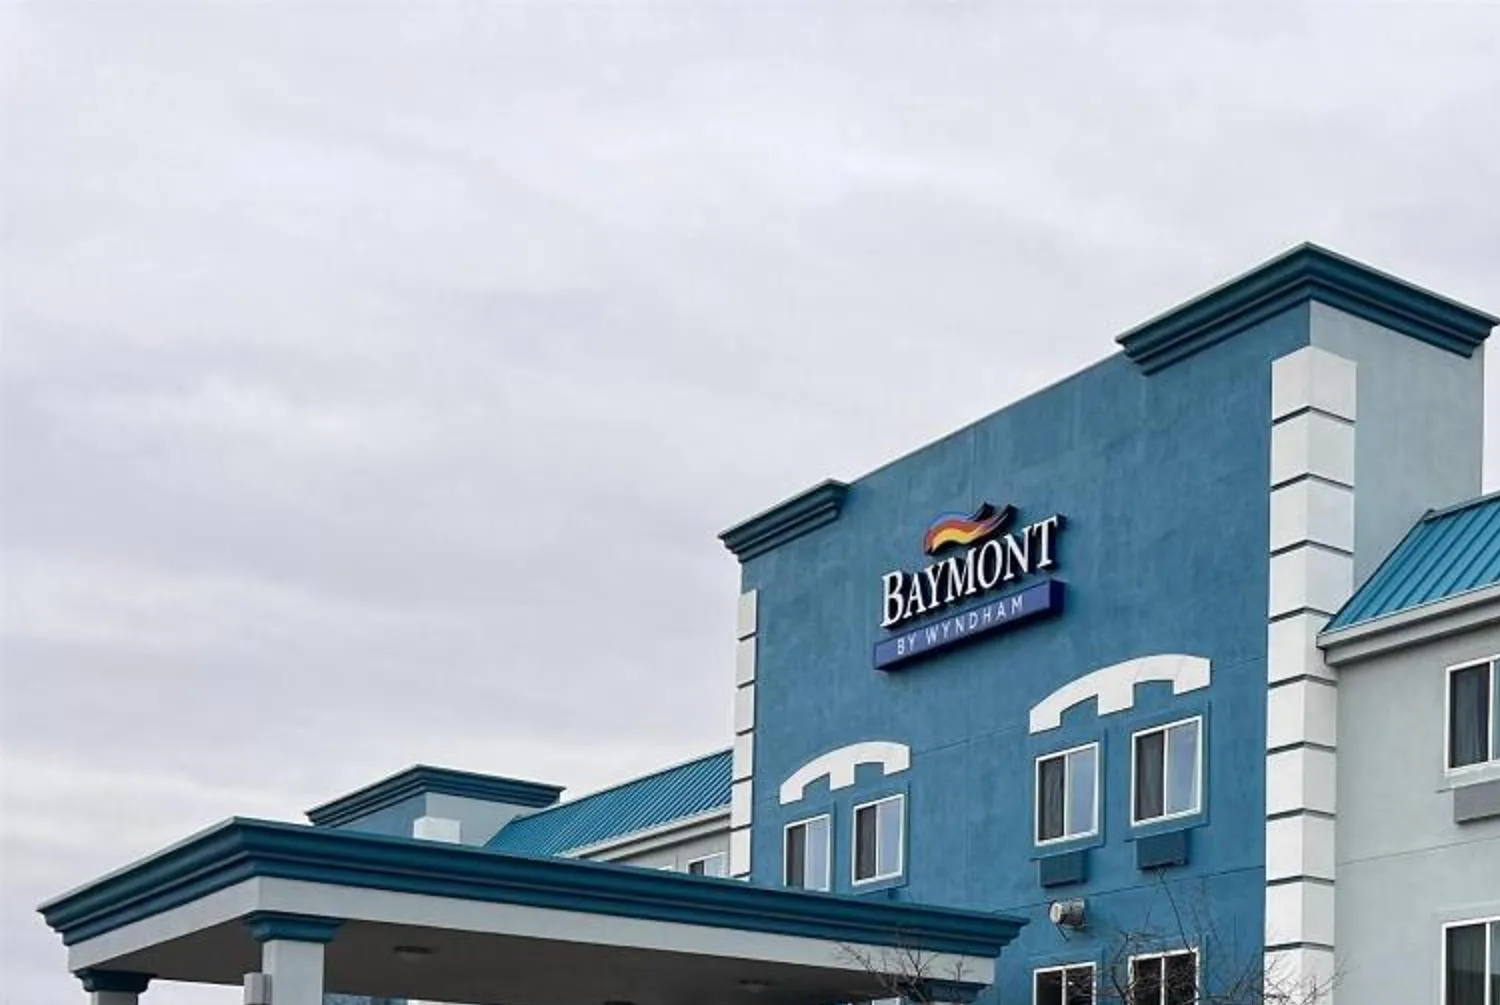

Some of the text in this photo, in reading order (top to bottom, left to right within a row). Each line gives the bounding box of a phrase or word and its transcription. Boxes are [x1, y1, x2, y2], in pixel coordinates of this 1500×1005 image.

[880, 515, 1059, 627] BAYMONT
[897, 595, 1024, 655] BY WYNDHAM
